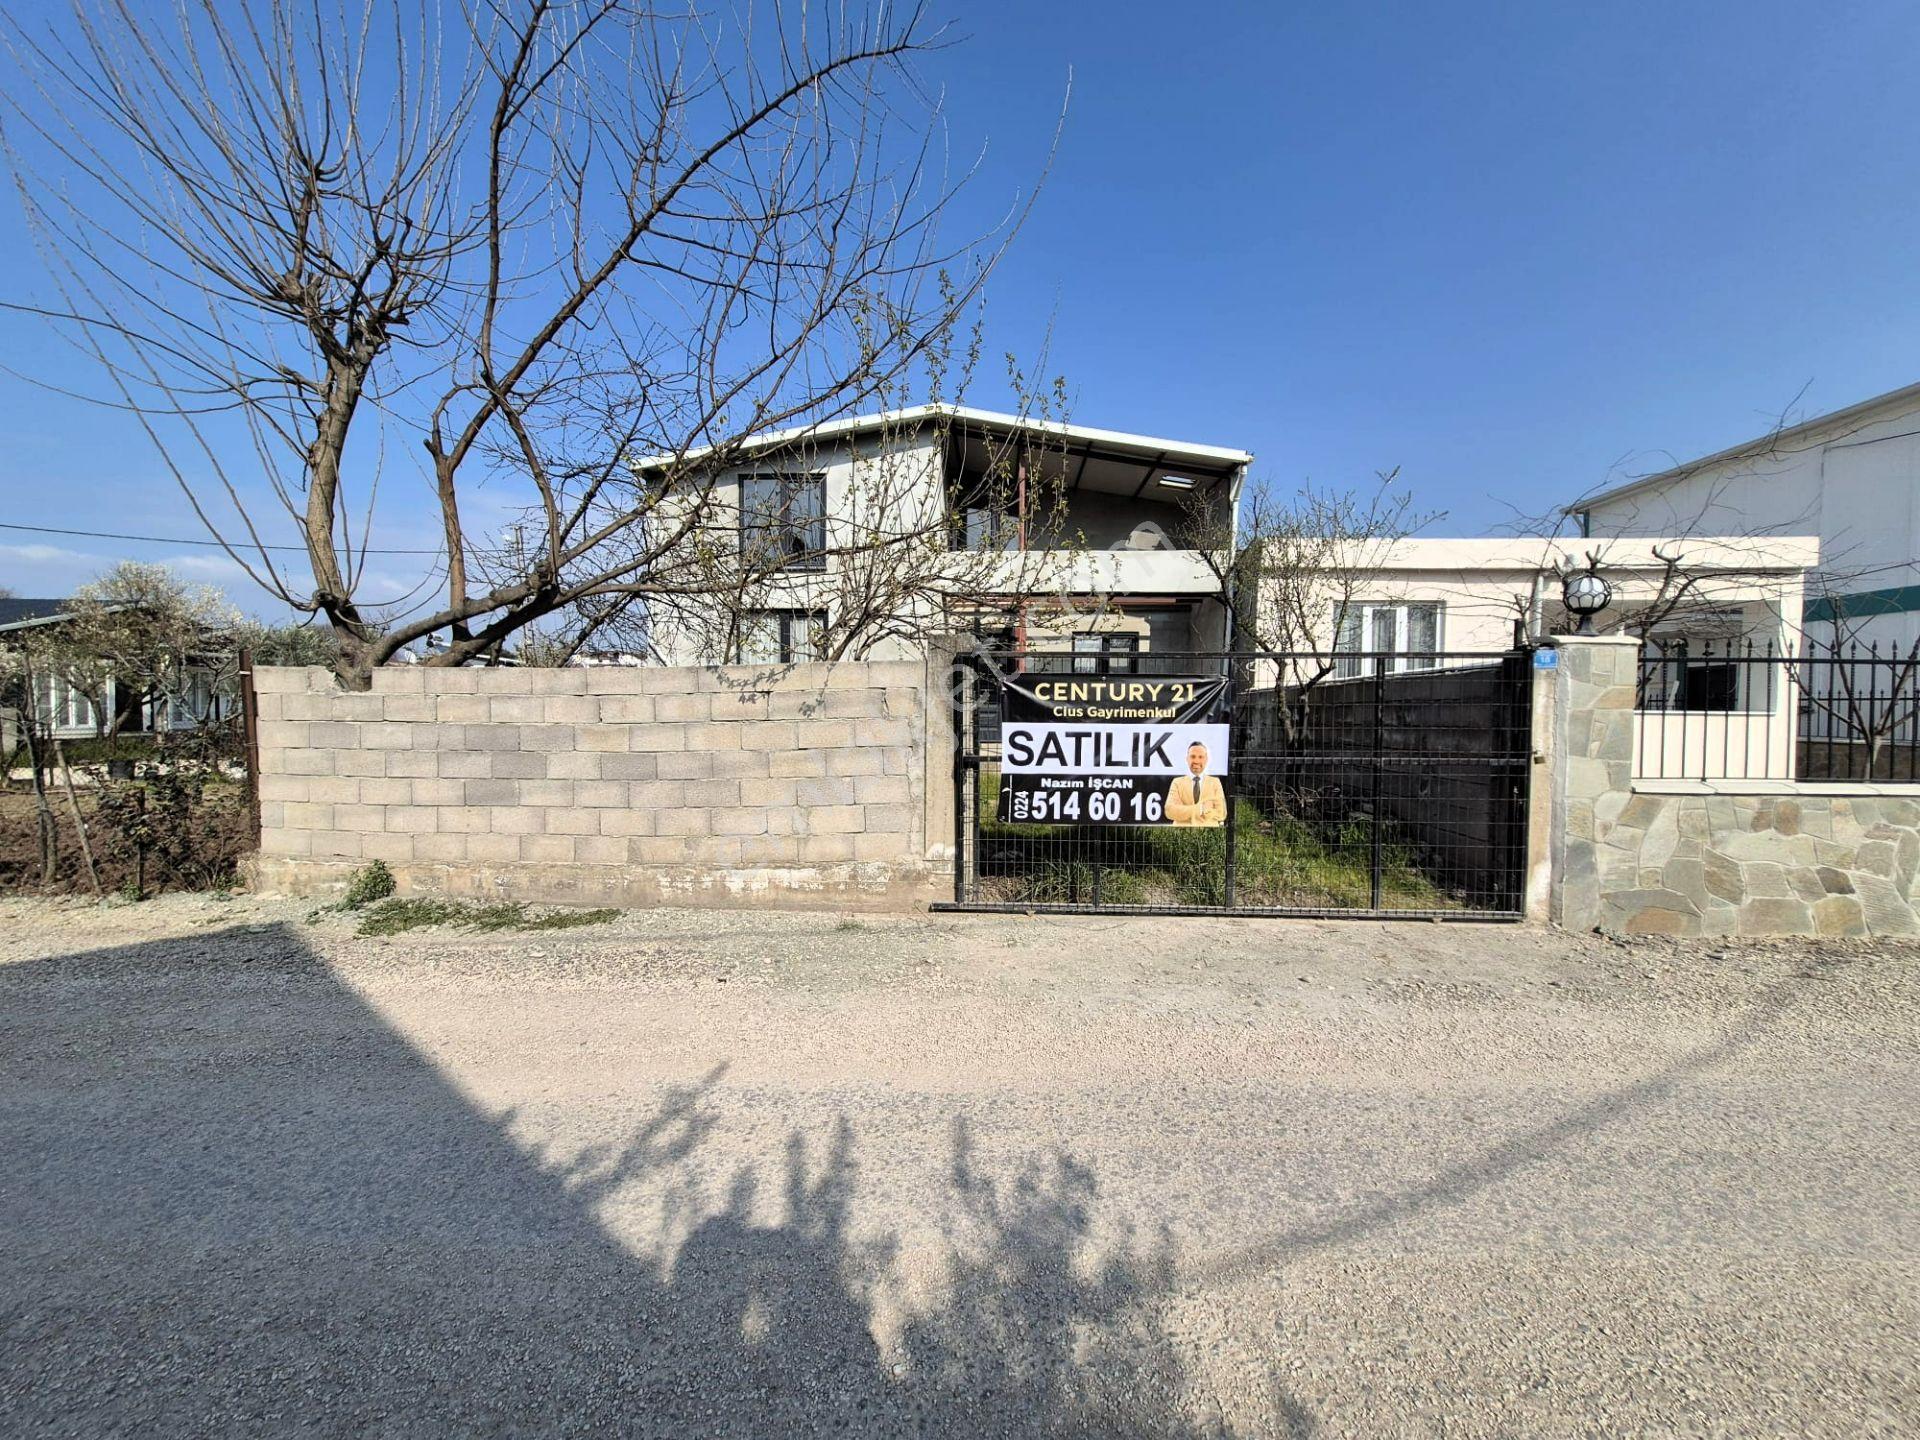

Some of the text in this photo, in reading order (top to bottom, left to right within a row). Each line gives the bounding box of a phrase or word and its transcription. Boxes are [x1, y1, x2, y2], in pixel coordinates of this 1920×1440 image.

[1035, 682, 1194, 702] CENTURY 21
[1087, 706, 1176, 720] Gayrimenkul
[1008, 731, 1173, 768] SATILIK
[1041, 776, 1133, 790] Nazım İŞCAN
[1014, 791, 1029, 819] 0224
[1031, 791, 1162, 821] 514 60 16
